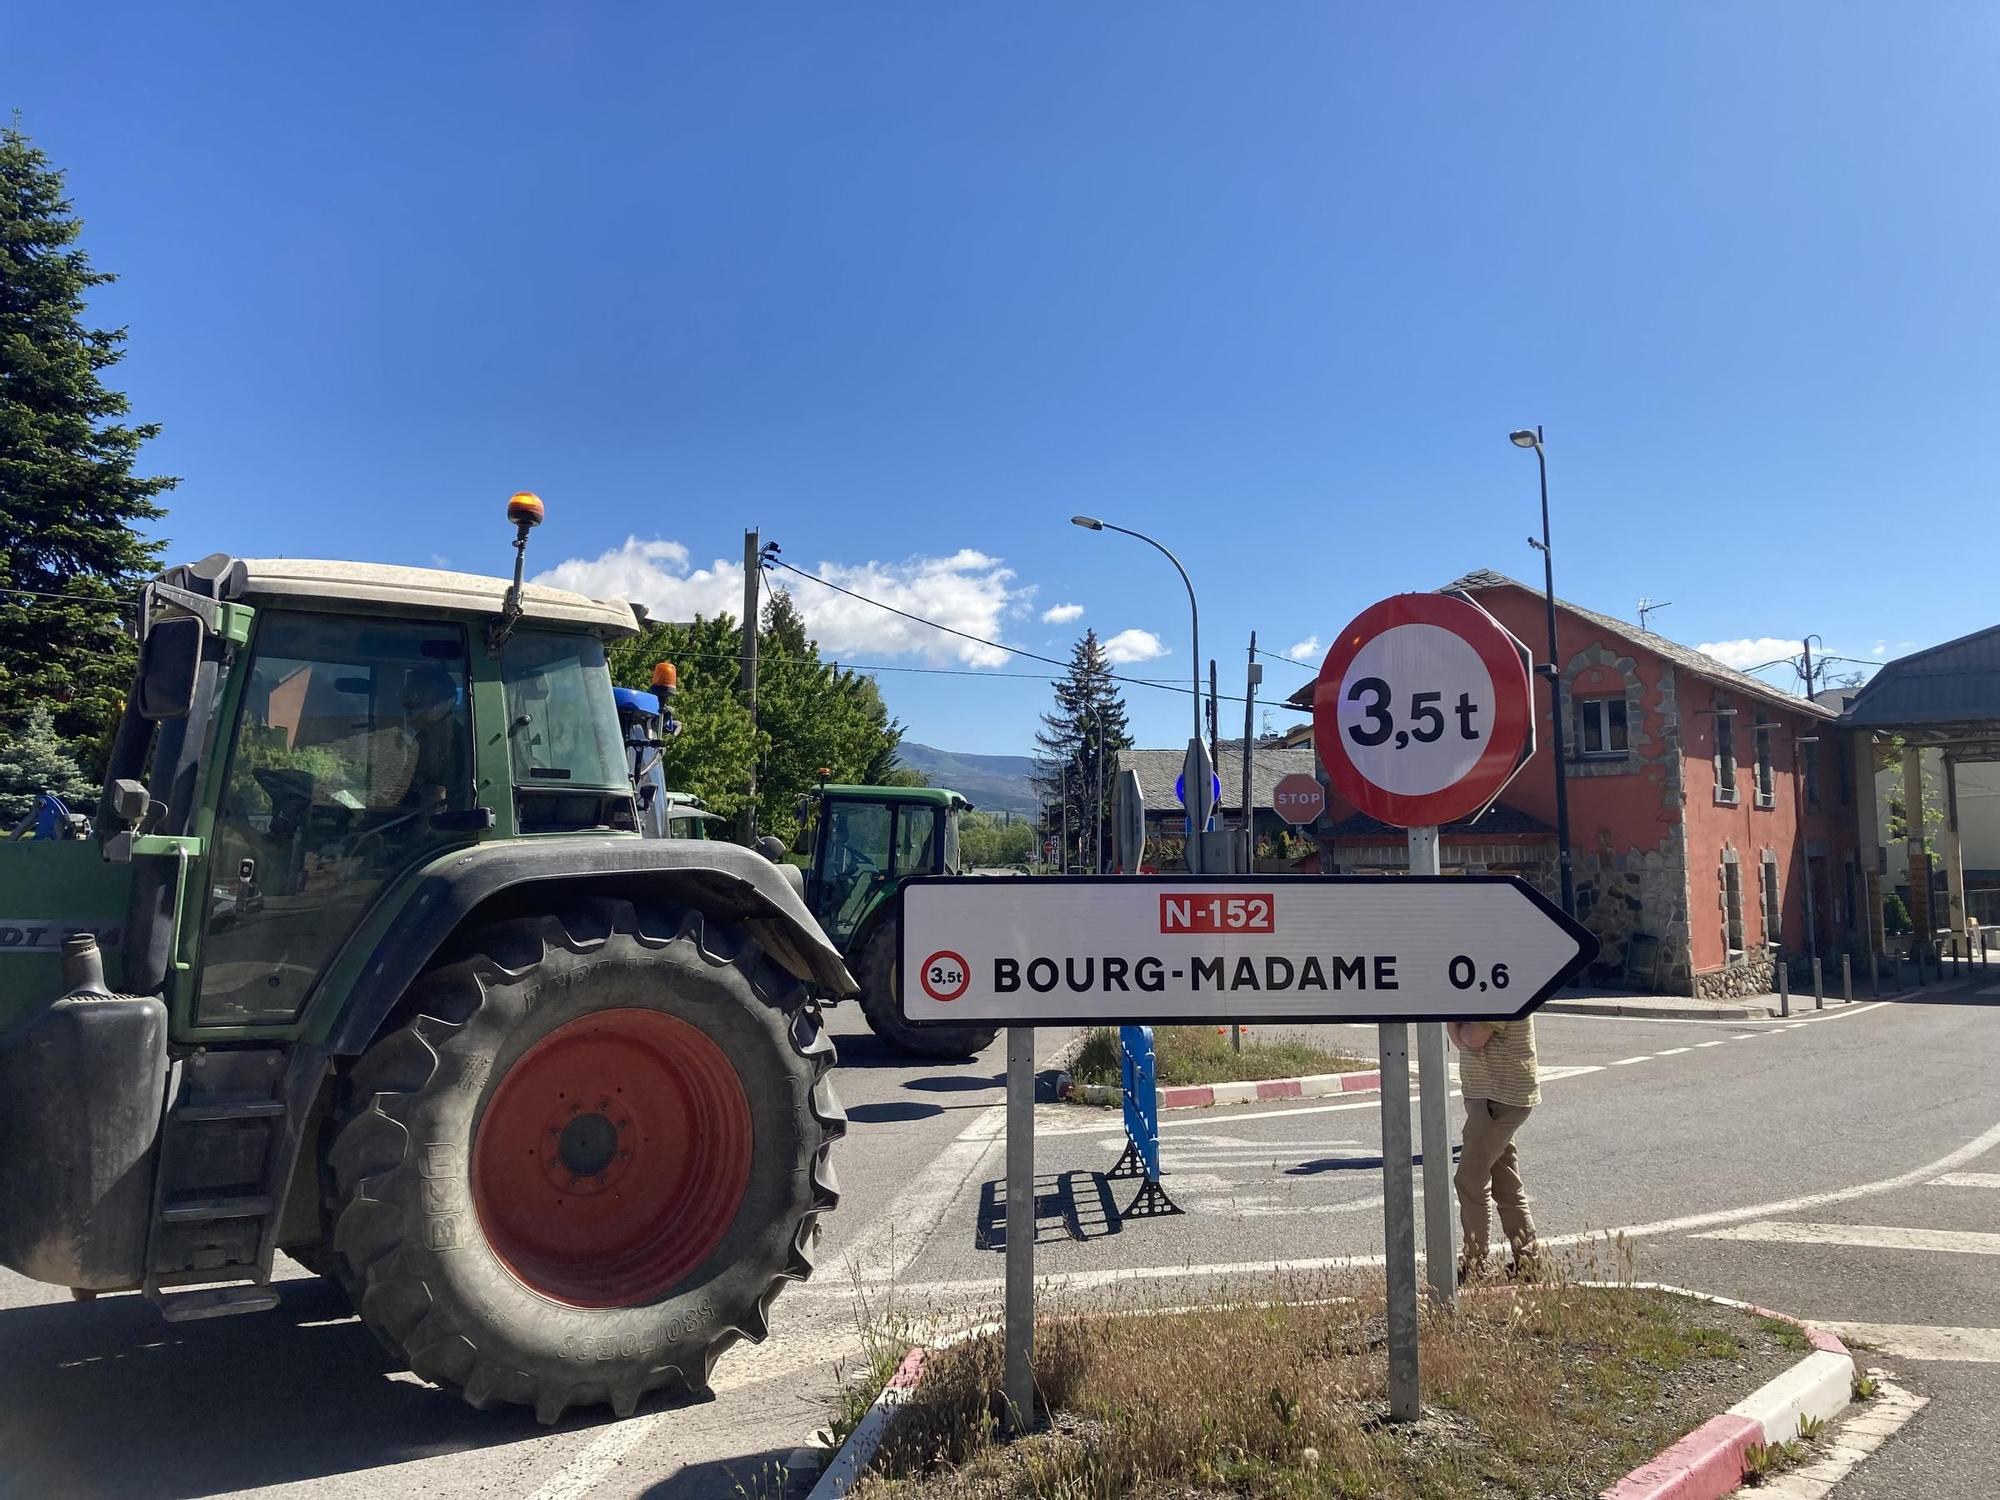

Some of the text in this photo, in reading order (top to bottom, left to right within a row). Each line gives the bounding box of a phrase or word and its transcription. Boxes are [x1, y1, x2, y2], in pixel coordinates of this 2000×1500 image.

[1278, 793, 1320, 805] STOP
[1166, 899, 1269, 928] N-152
[931, 967, 962, 985] 3,5t
[994, 954, 1510, 993] BOURG-MADAME 0,6
